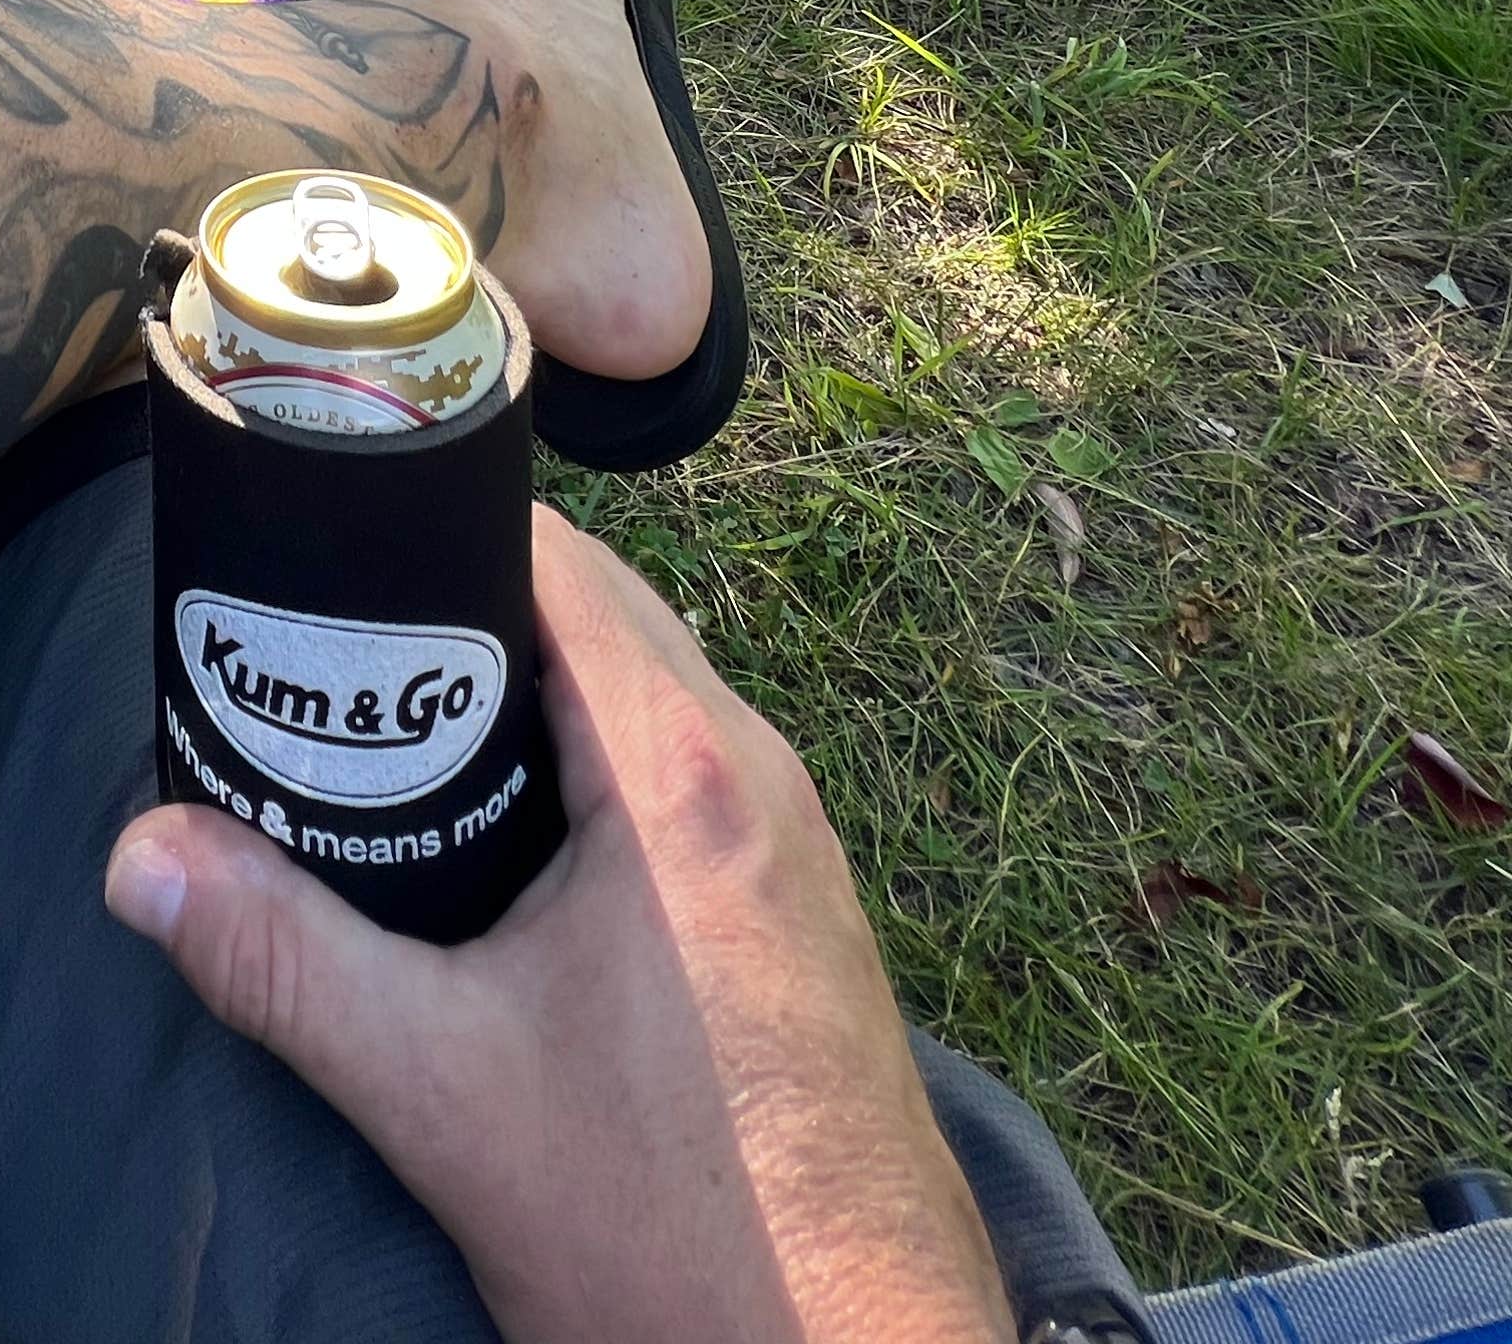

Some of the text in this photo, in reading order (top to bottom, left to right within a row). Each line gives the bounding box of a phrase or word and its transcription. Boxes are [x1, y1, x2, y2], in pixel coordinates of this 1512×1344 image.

[201, 619, 474, 740] Kum & Go
[259, 800, 295, 848] &
[303, 825, 442, 864] means
[454, 763, 527, 846] more
